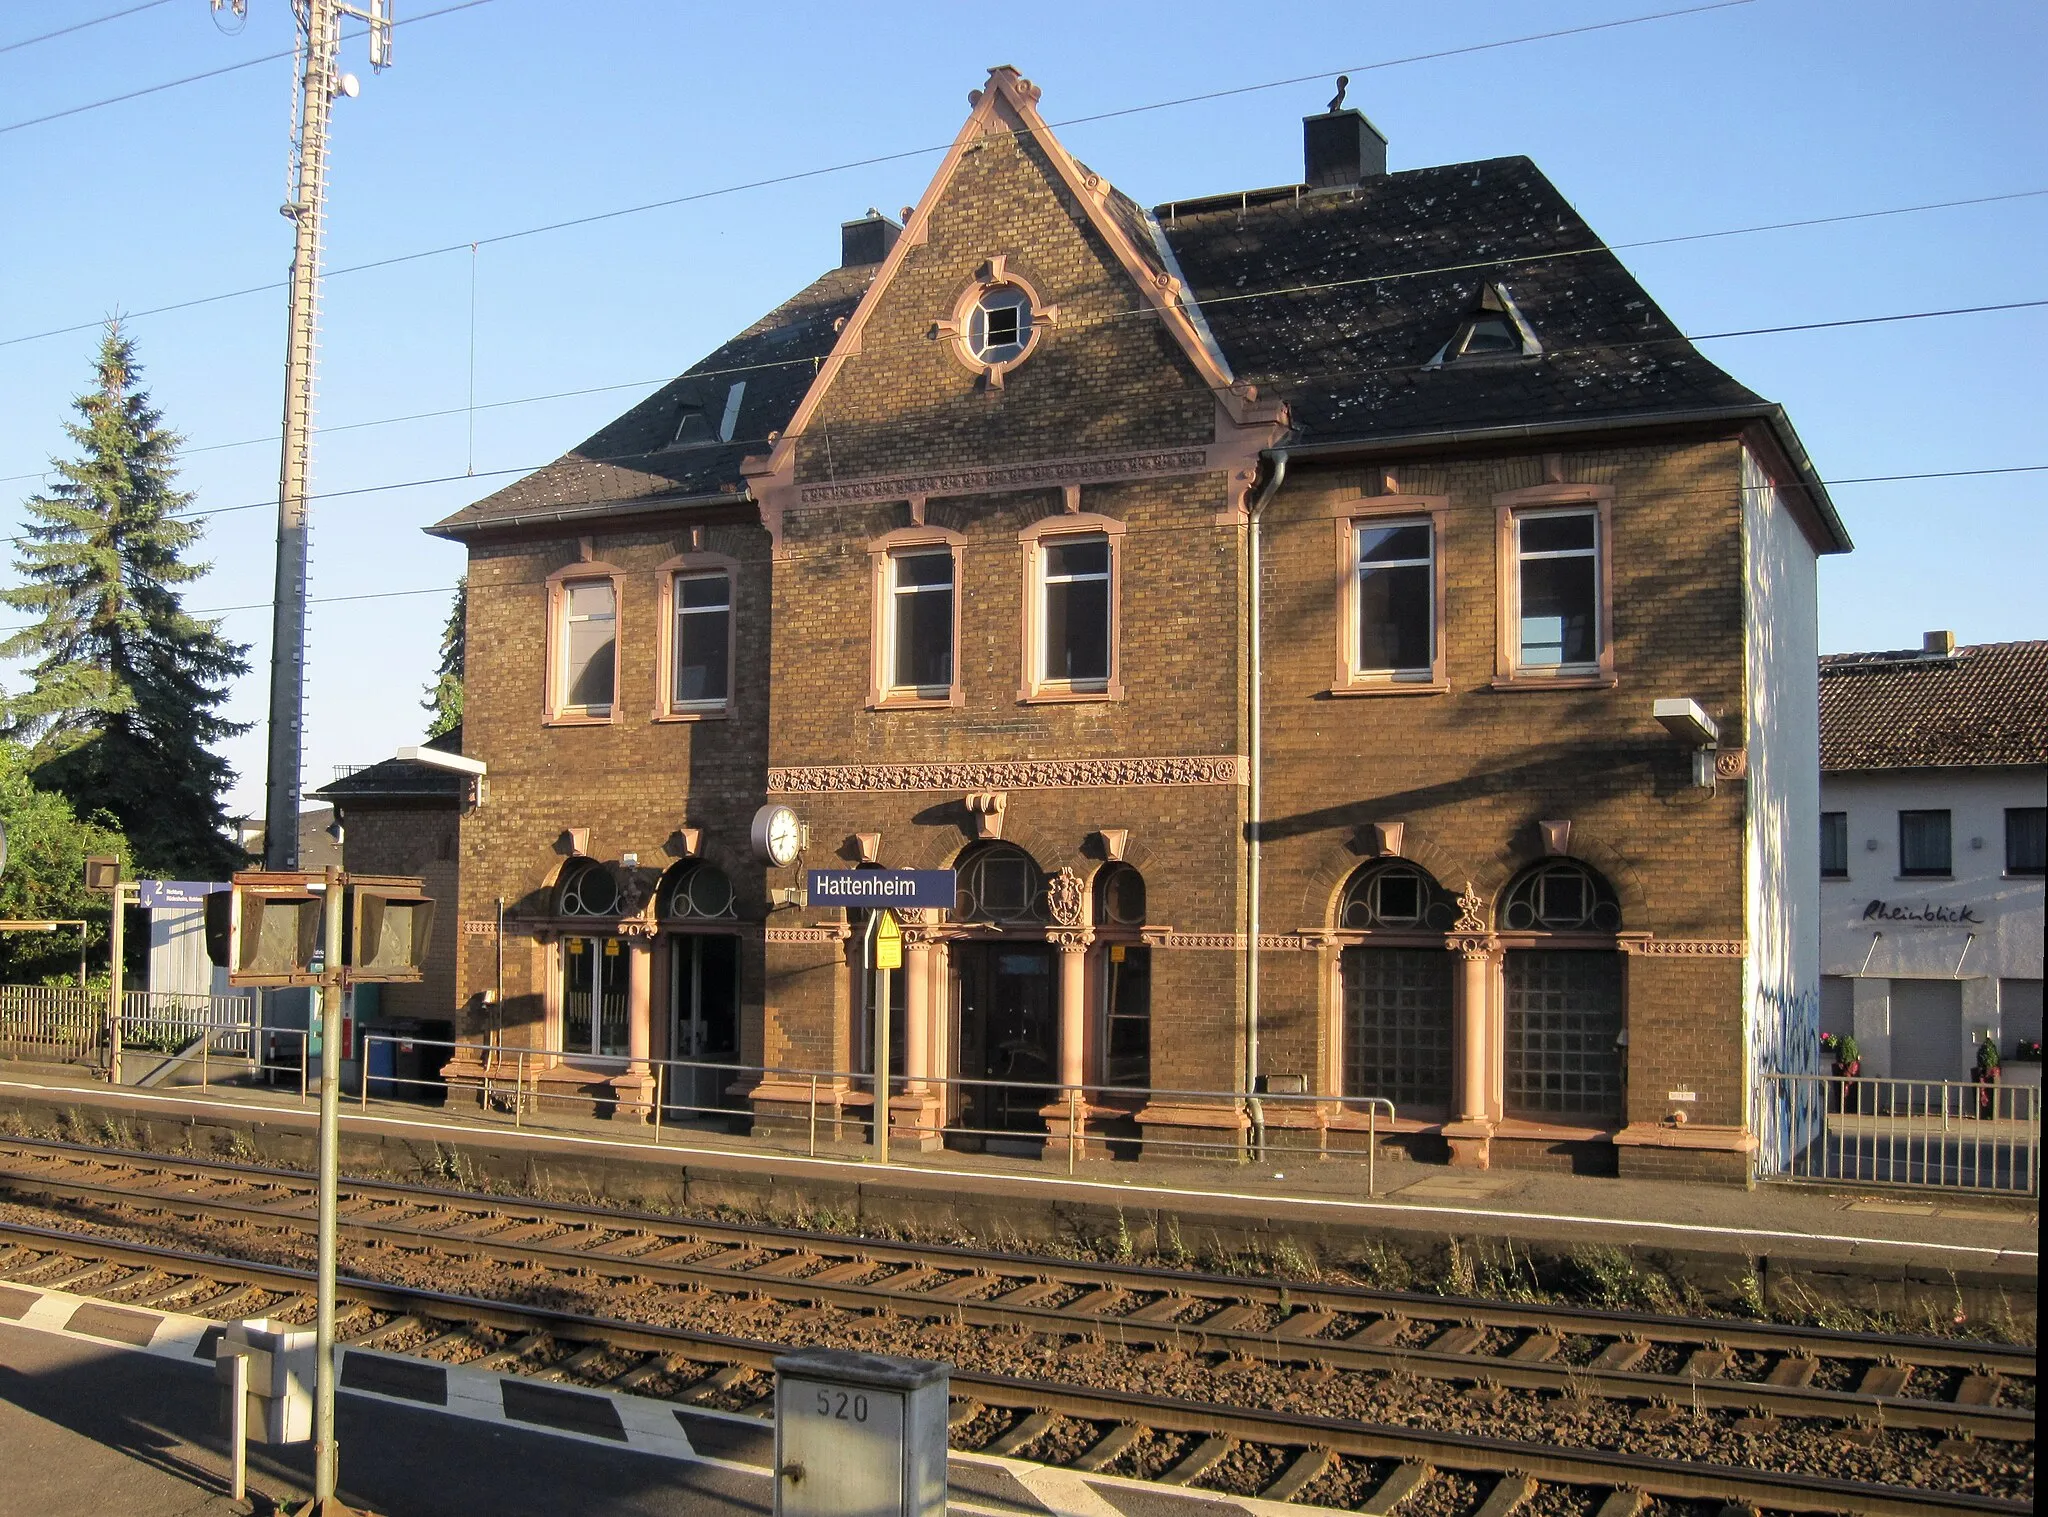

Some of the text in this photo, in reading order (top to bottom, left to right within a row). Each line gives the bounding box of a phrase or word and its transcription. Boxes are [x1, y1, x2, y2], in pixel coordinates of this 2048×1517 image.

[155, 881, 163, 895] 2
[817, 875, 916, 896] Hattenheim
[1862, 899, 1984, 924] Rheinblick
[817, 1388, 868, 1423] 520
